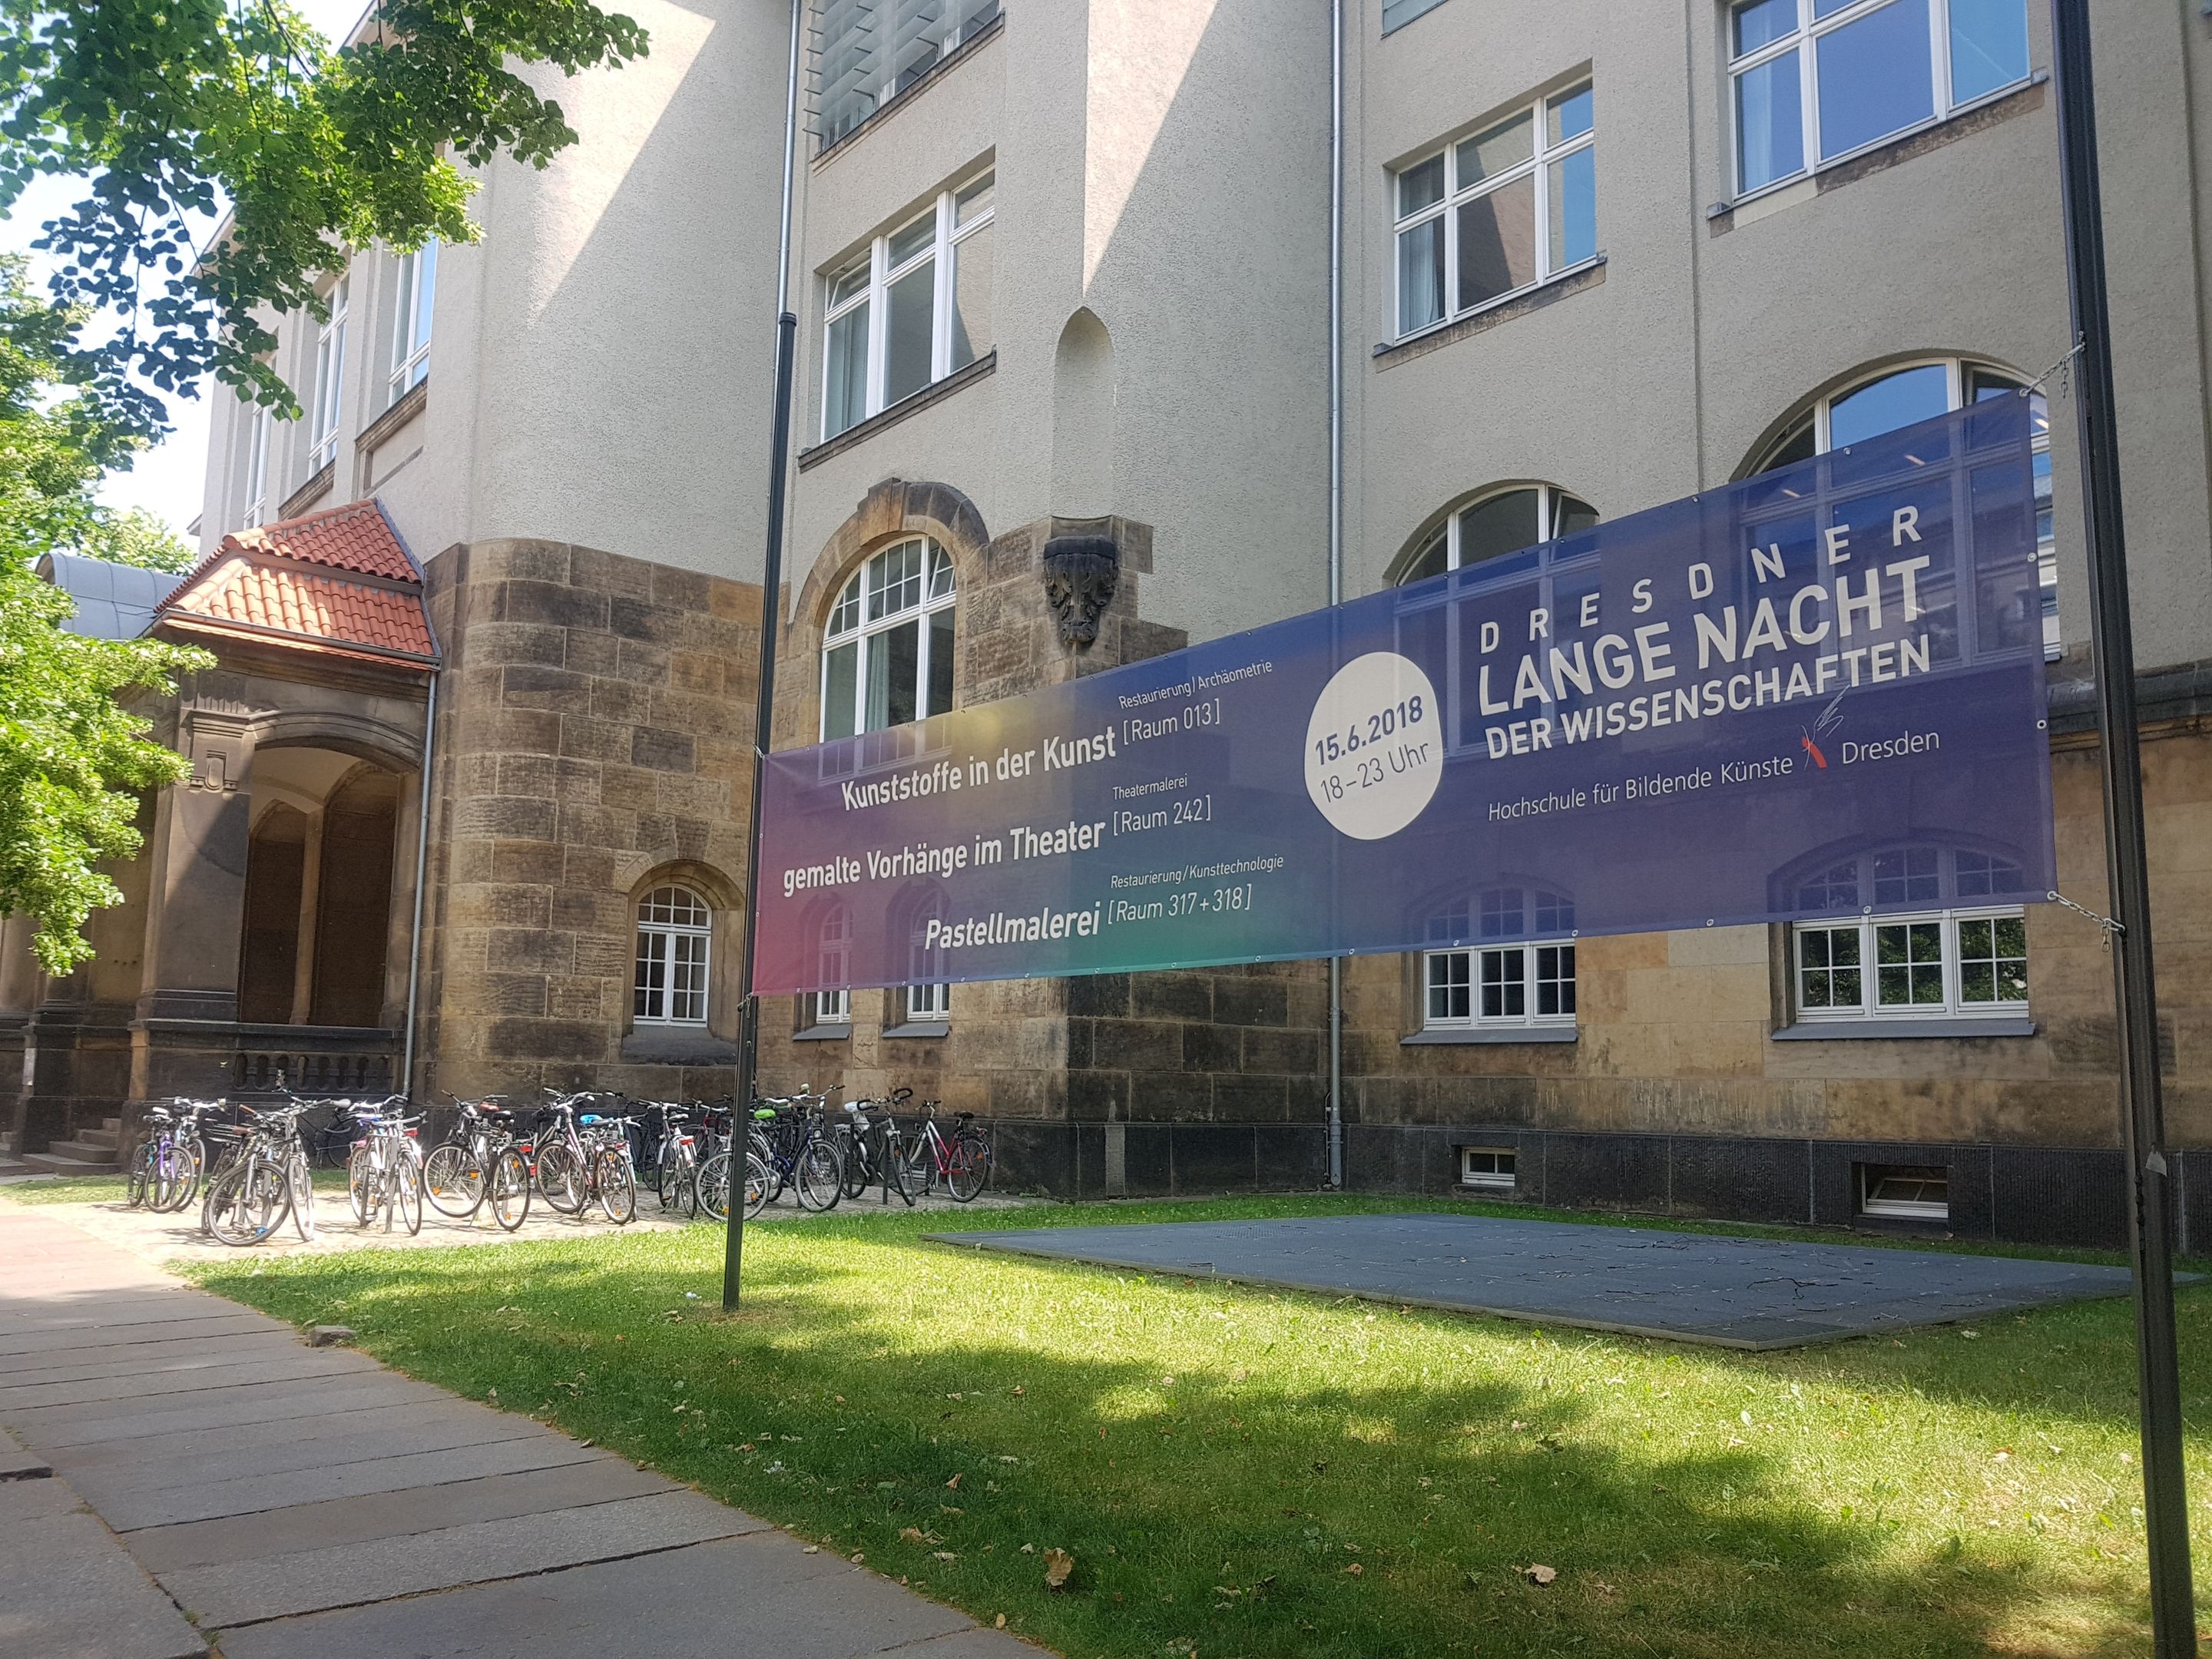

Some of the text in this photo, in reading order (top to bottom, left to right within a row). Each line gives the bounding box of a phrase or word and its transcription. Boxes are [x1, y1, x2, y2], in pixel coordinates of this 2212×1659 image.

[1479, 556, 1929, 715] LANGE NACHT
[1315, 695, 1423, 765] 15.6.2018
[1485, 634, 1930, 760] DER WISSENSCHAFTEN
[842, 727, 1116, 810] Kunststoffe in der Kunst
[1113, 775, 1187, 800] Theatermalerei
[1387, 739, 1429, 773] Uhr
[1488, 730, 1940, 820] Hochschule für Bildende Künste Dresden
[783, 820, 1105, 897] gemalte Vorhänge im Theater
[925, 902, 1100, 949] Pastellmalerei
